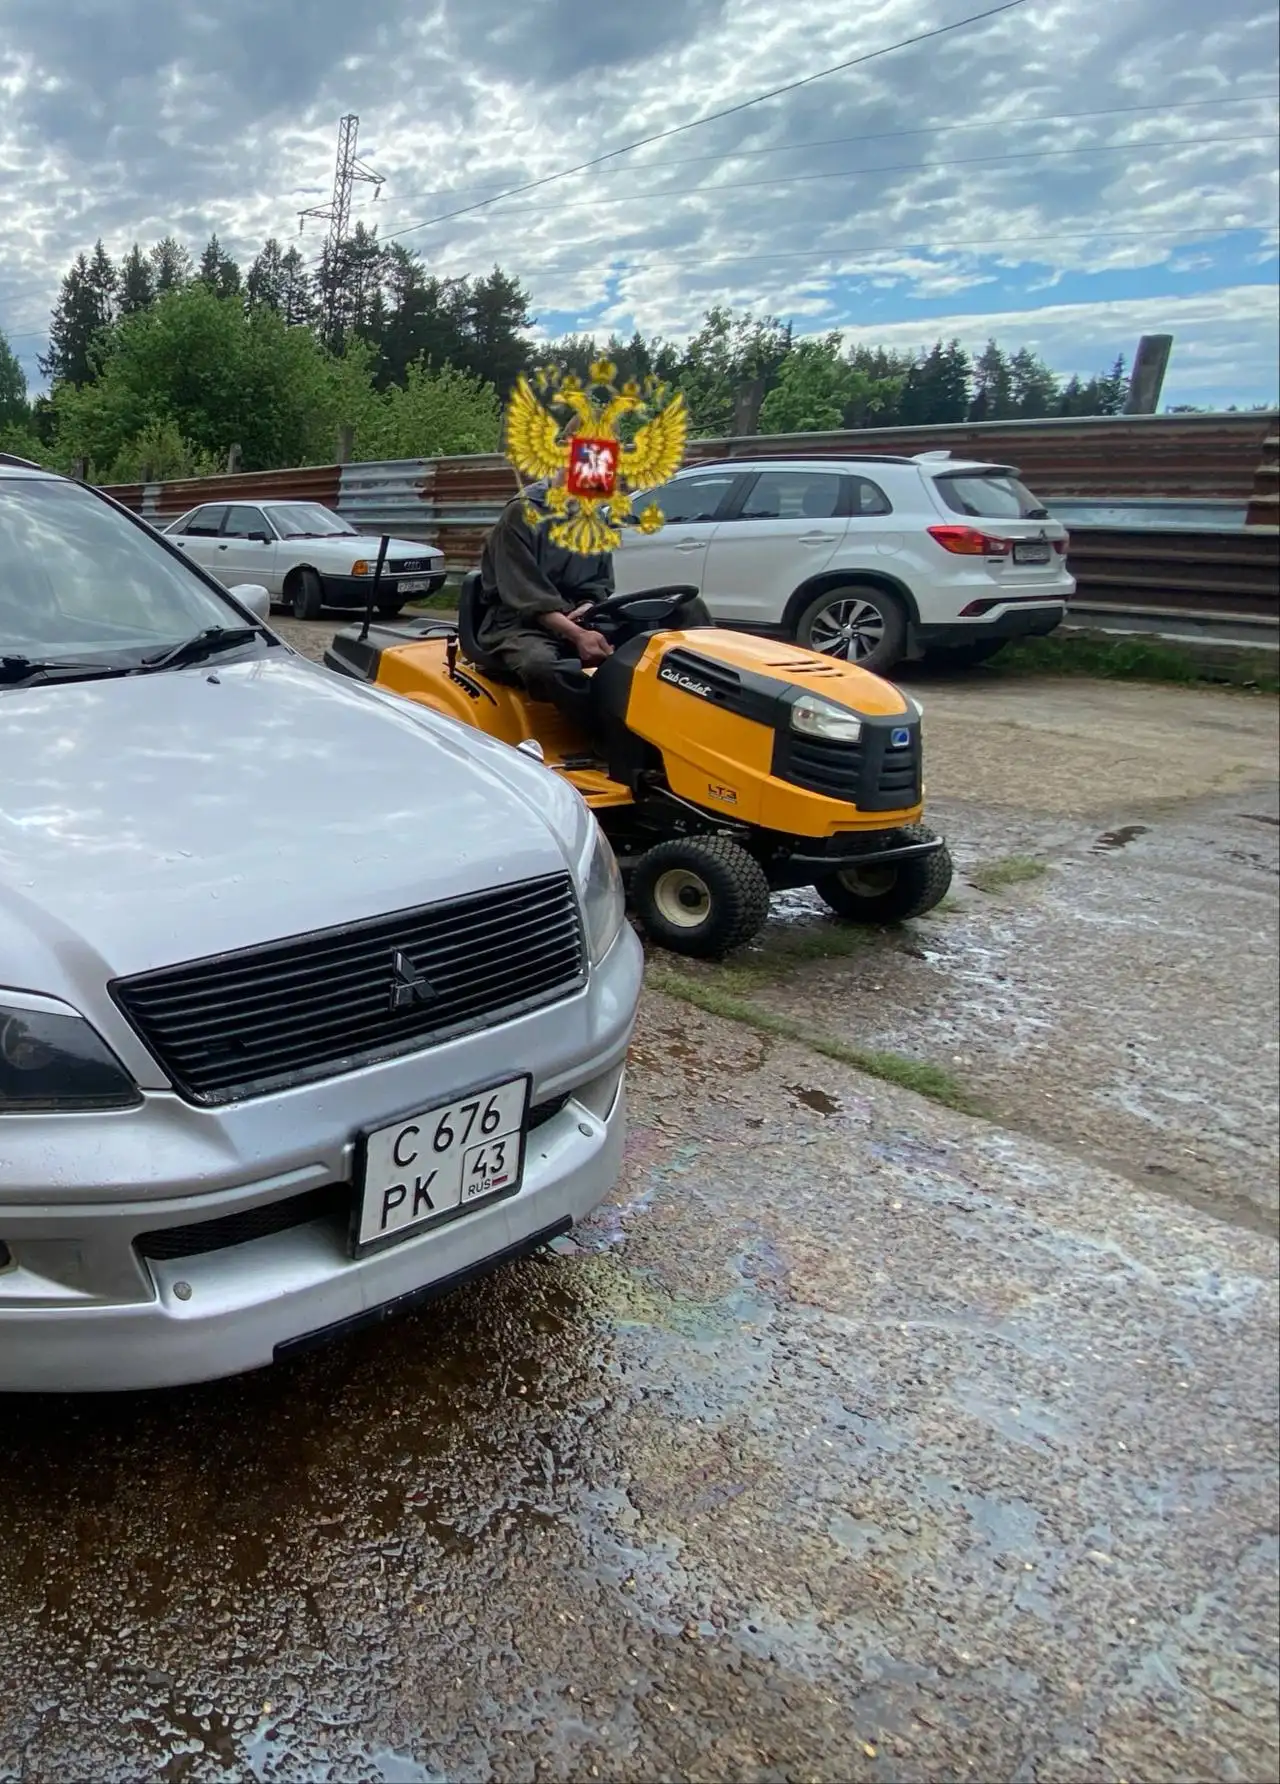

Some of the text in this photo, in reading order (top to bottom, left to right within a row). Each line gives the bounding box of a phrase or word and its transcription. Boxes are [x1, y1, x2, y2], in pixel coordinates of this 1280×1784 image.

[661, 669, 713, 697] Cub Cadet
[393, 1094, 502, 1168] С 676
[471, 1141, 506, 1179] 43
[380, 1170, 439, 1230] РК
[467, 1178, 491, 1196] RUS
